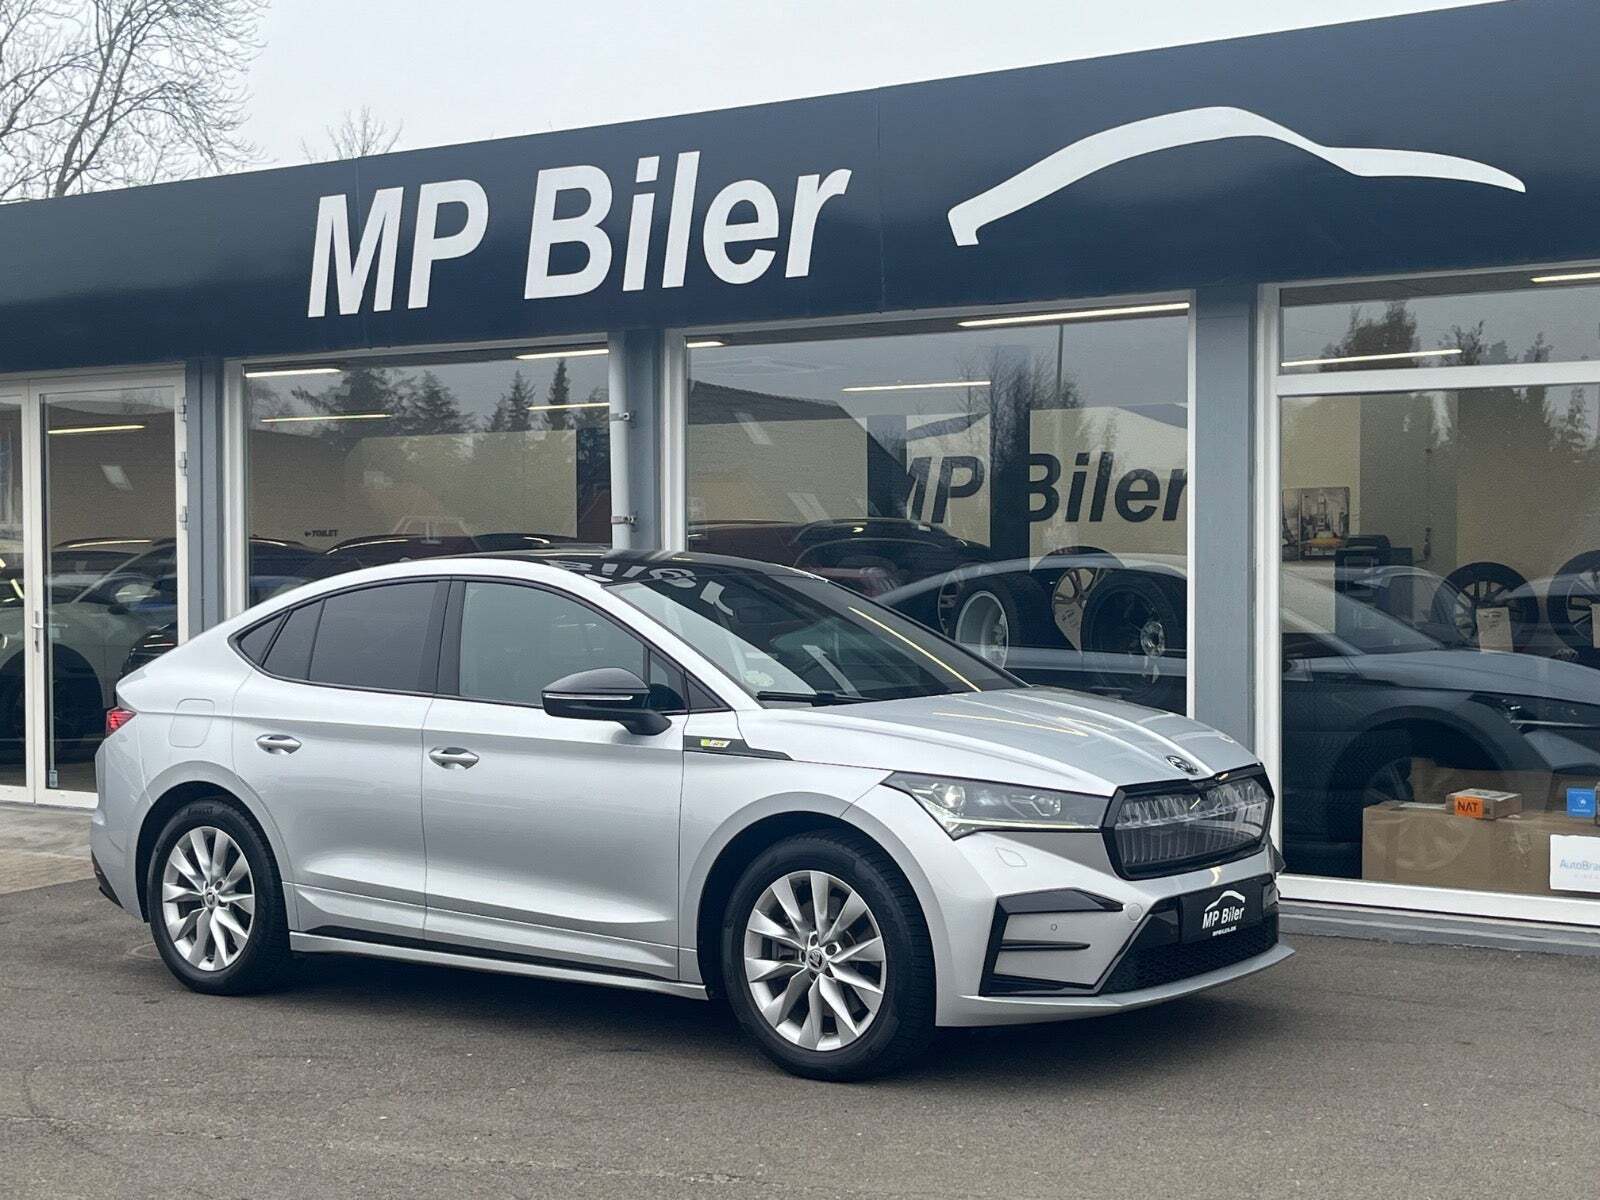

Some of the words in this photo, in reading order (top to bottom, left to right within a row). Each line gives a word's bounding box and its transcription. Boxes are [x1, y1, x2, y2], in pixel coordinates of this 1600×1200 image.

[308, 180, 489, 318] MP
[524, 151, 852, 299] Biler
[1028, 451, 1188, 523] Biler
[1457, 800, 1479, 813] NAT
[1559, 859, 1600, 872] AutoBra
[1202, 910, 1220, 929] MP
[1221, 906, 1245, 924] Biler
